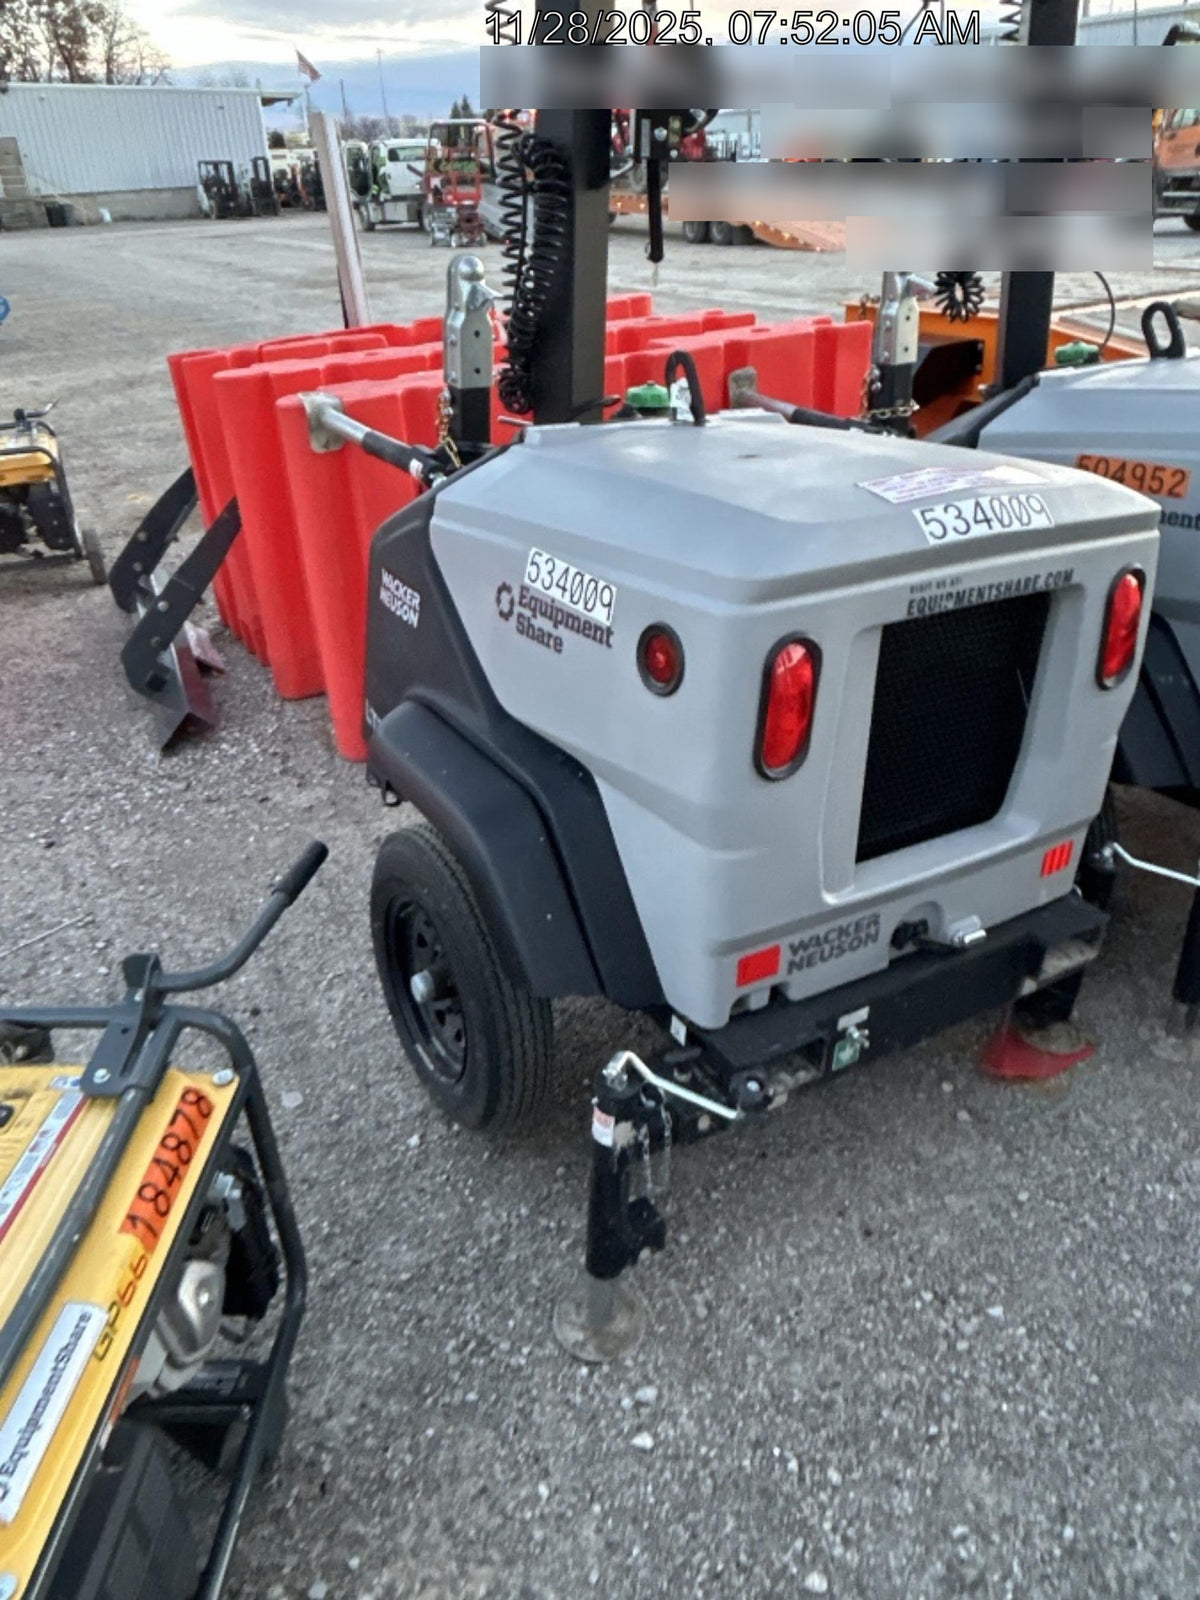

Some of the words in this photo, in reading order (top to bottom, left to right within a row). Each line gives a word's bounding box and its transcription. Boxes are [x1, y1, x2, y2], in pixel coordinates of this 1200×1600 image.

[920, 494, 1053, 540] 534009
[380, 585, 419, 629] NEUSON
[381, 567, 420, 611] WACKER
[527, 550, 615, 622] 534009
[906, 568, 1075, 617] EQUIPMENTSHARE.COM
[515, 611, 563, 655] Share
[518, 585, 614, 649] Equipment
[787, 931, 880, 976] NEUSON
[788, 913, 881, 957] WACKER
[126, 1086, 212, 1241] 184878
[0, 1311, 92, 1479] EquipmentShare
